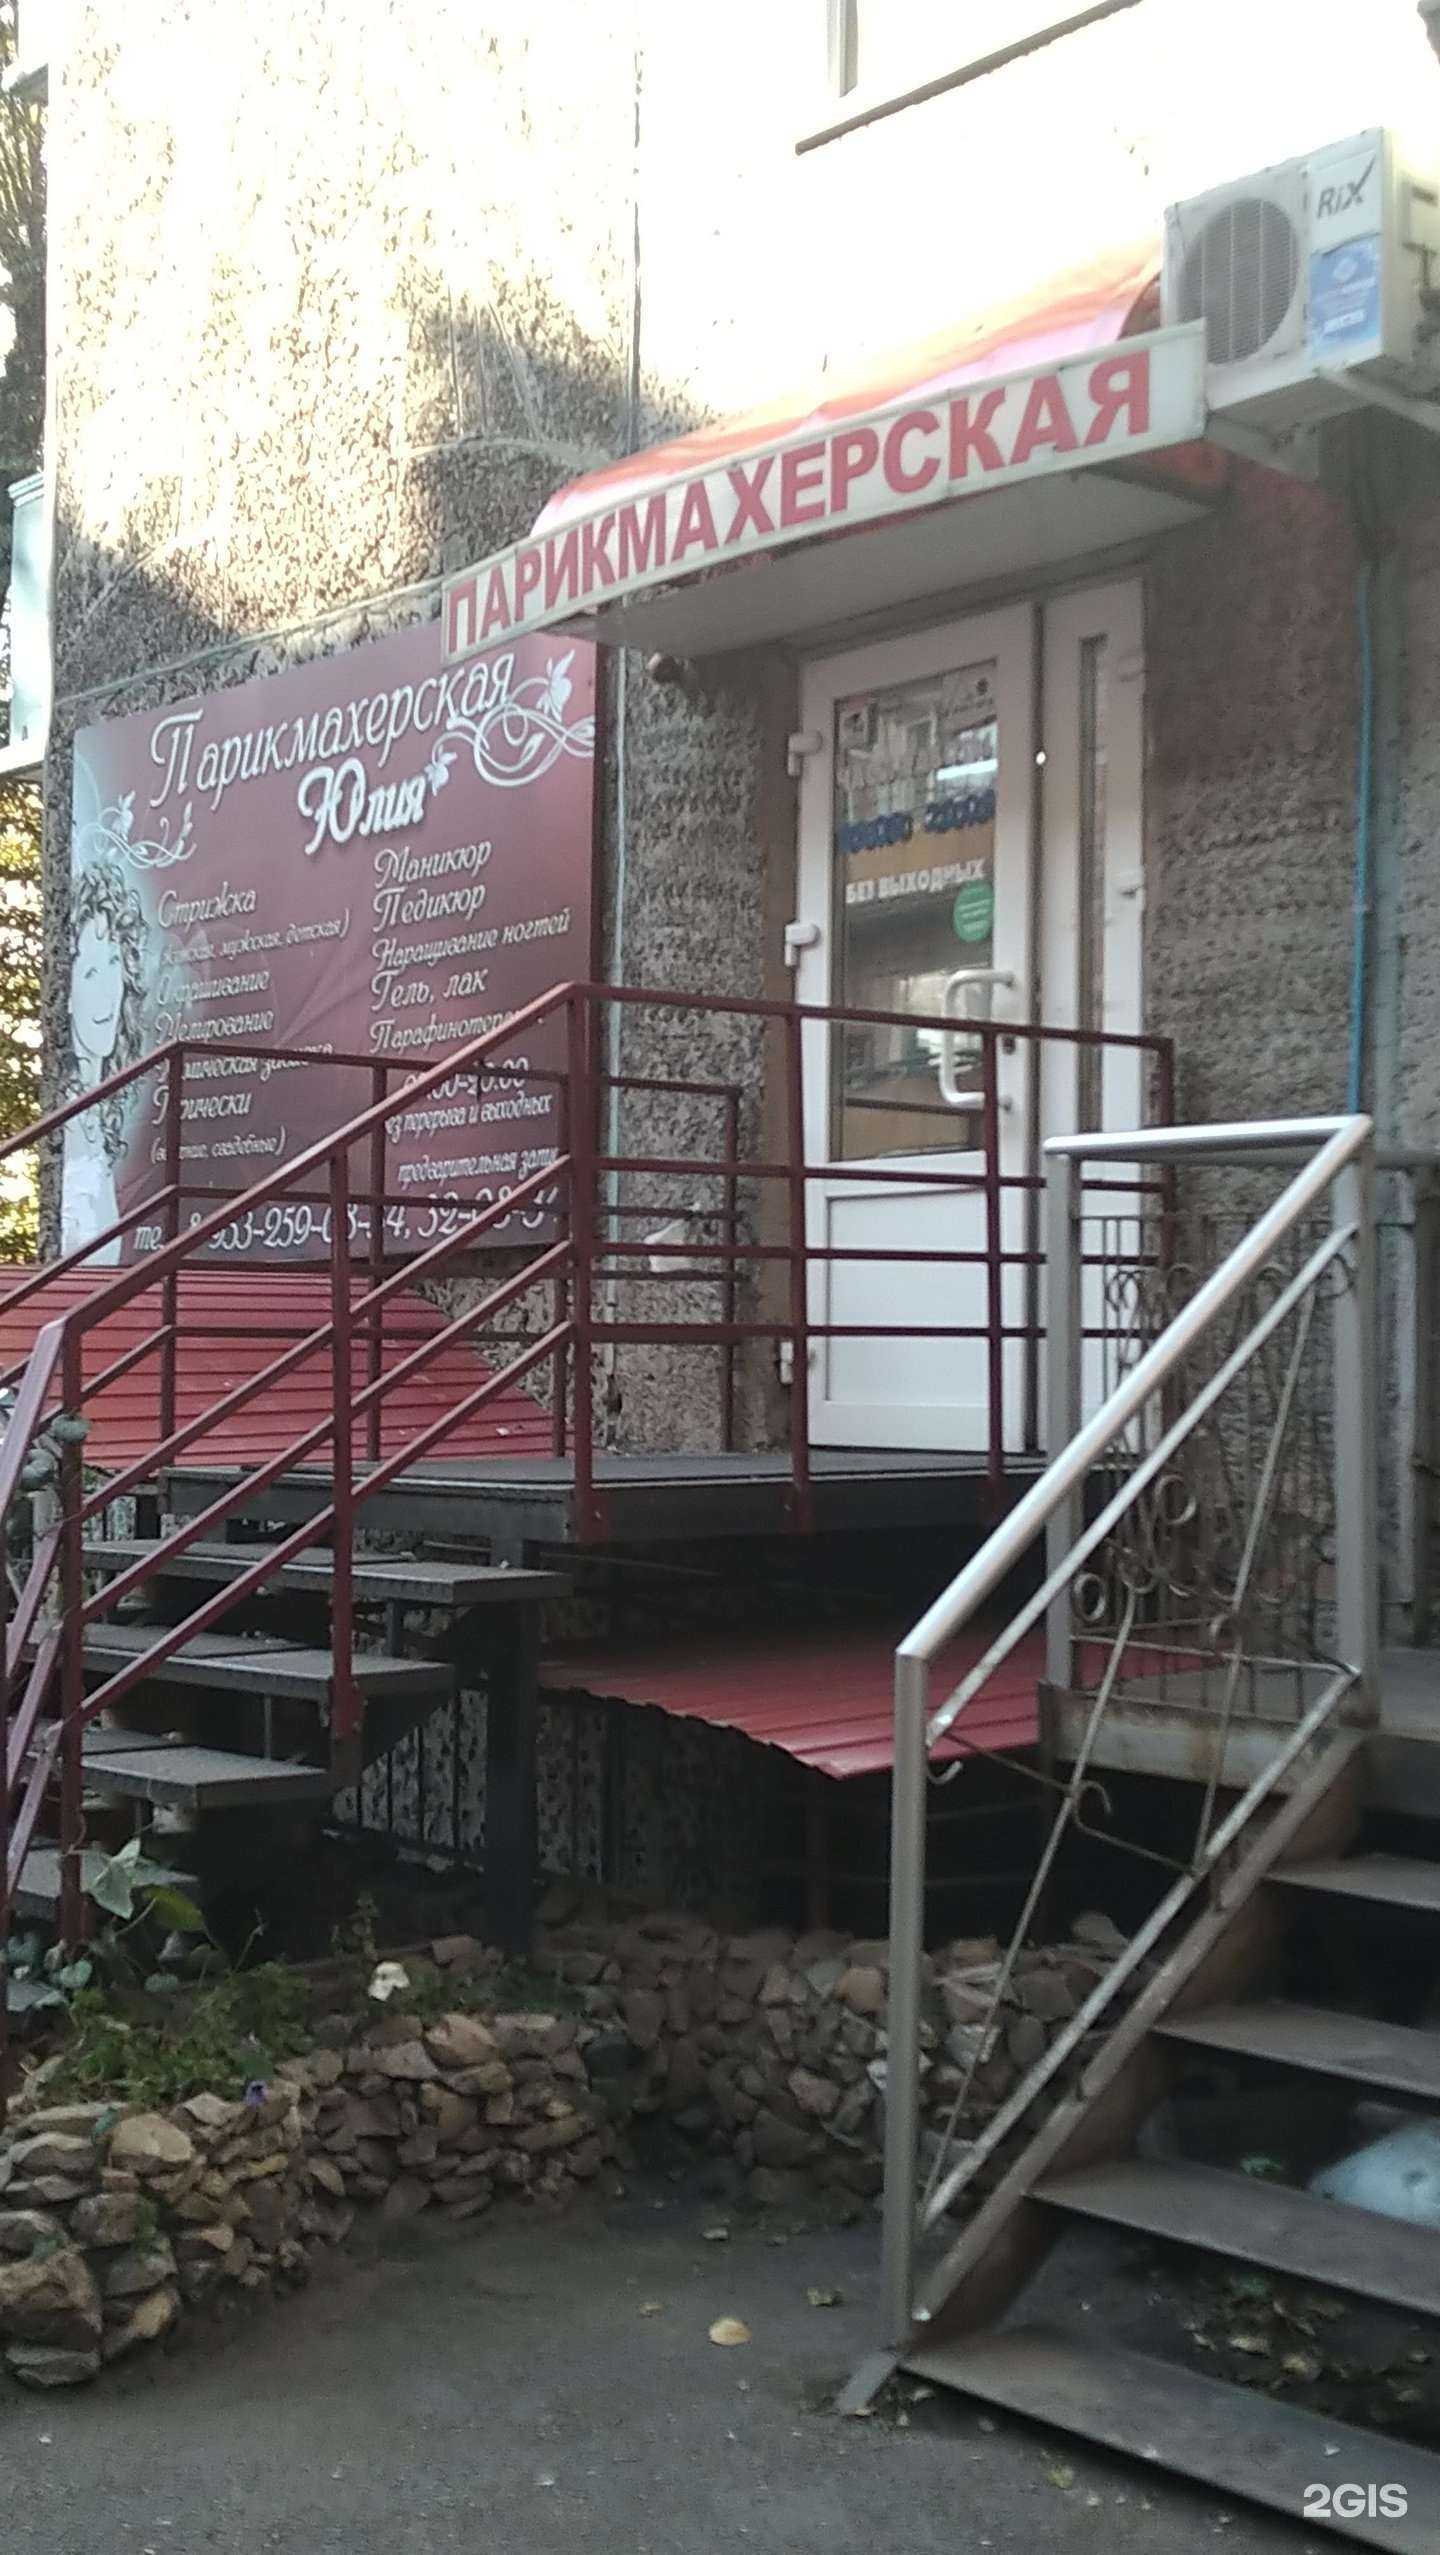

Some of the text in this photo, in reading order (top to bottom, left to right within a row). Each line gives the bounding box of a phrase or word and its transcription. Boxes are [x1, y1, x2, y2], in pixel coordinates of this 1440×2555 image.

[448, 350, 1150, 653] ПАРИКМАХЕРСКАЯ
[150, 652, 515, 811] Парикмахерская
[299, 756, 427, 855] Юлия
[374, 841, 491, 889] Маникюр
[158, 881, 256, 933] Стрижка
[372, 884, 486, 932] Педикюр
[372, 907, 570, 972] Наращивание ногтей
[371, 969, 489, 1010] Гель, лак
